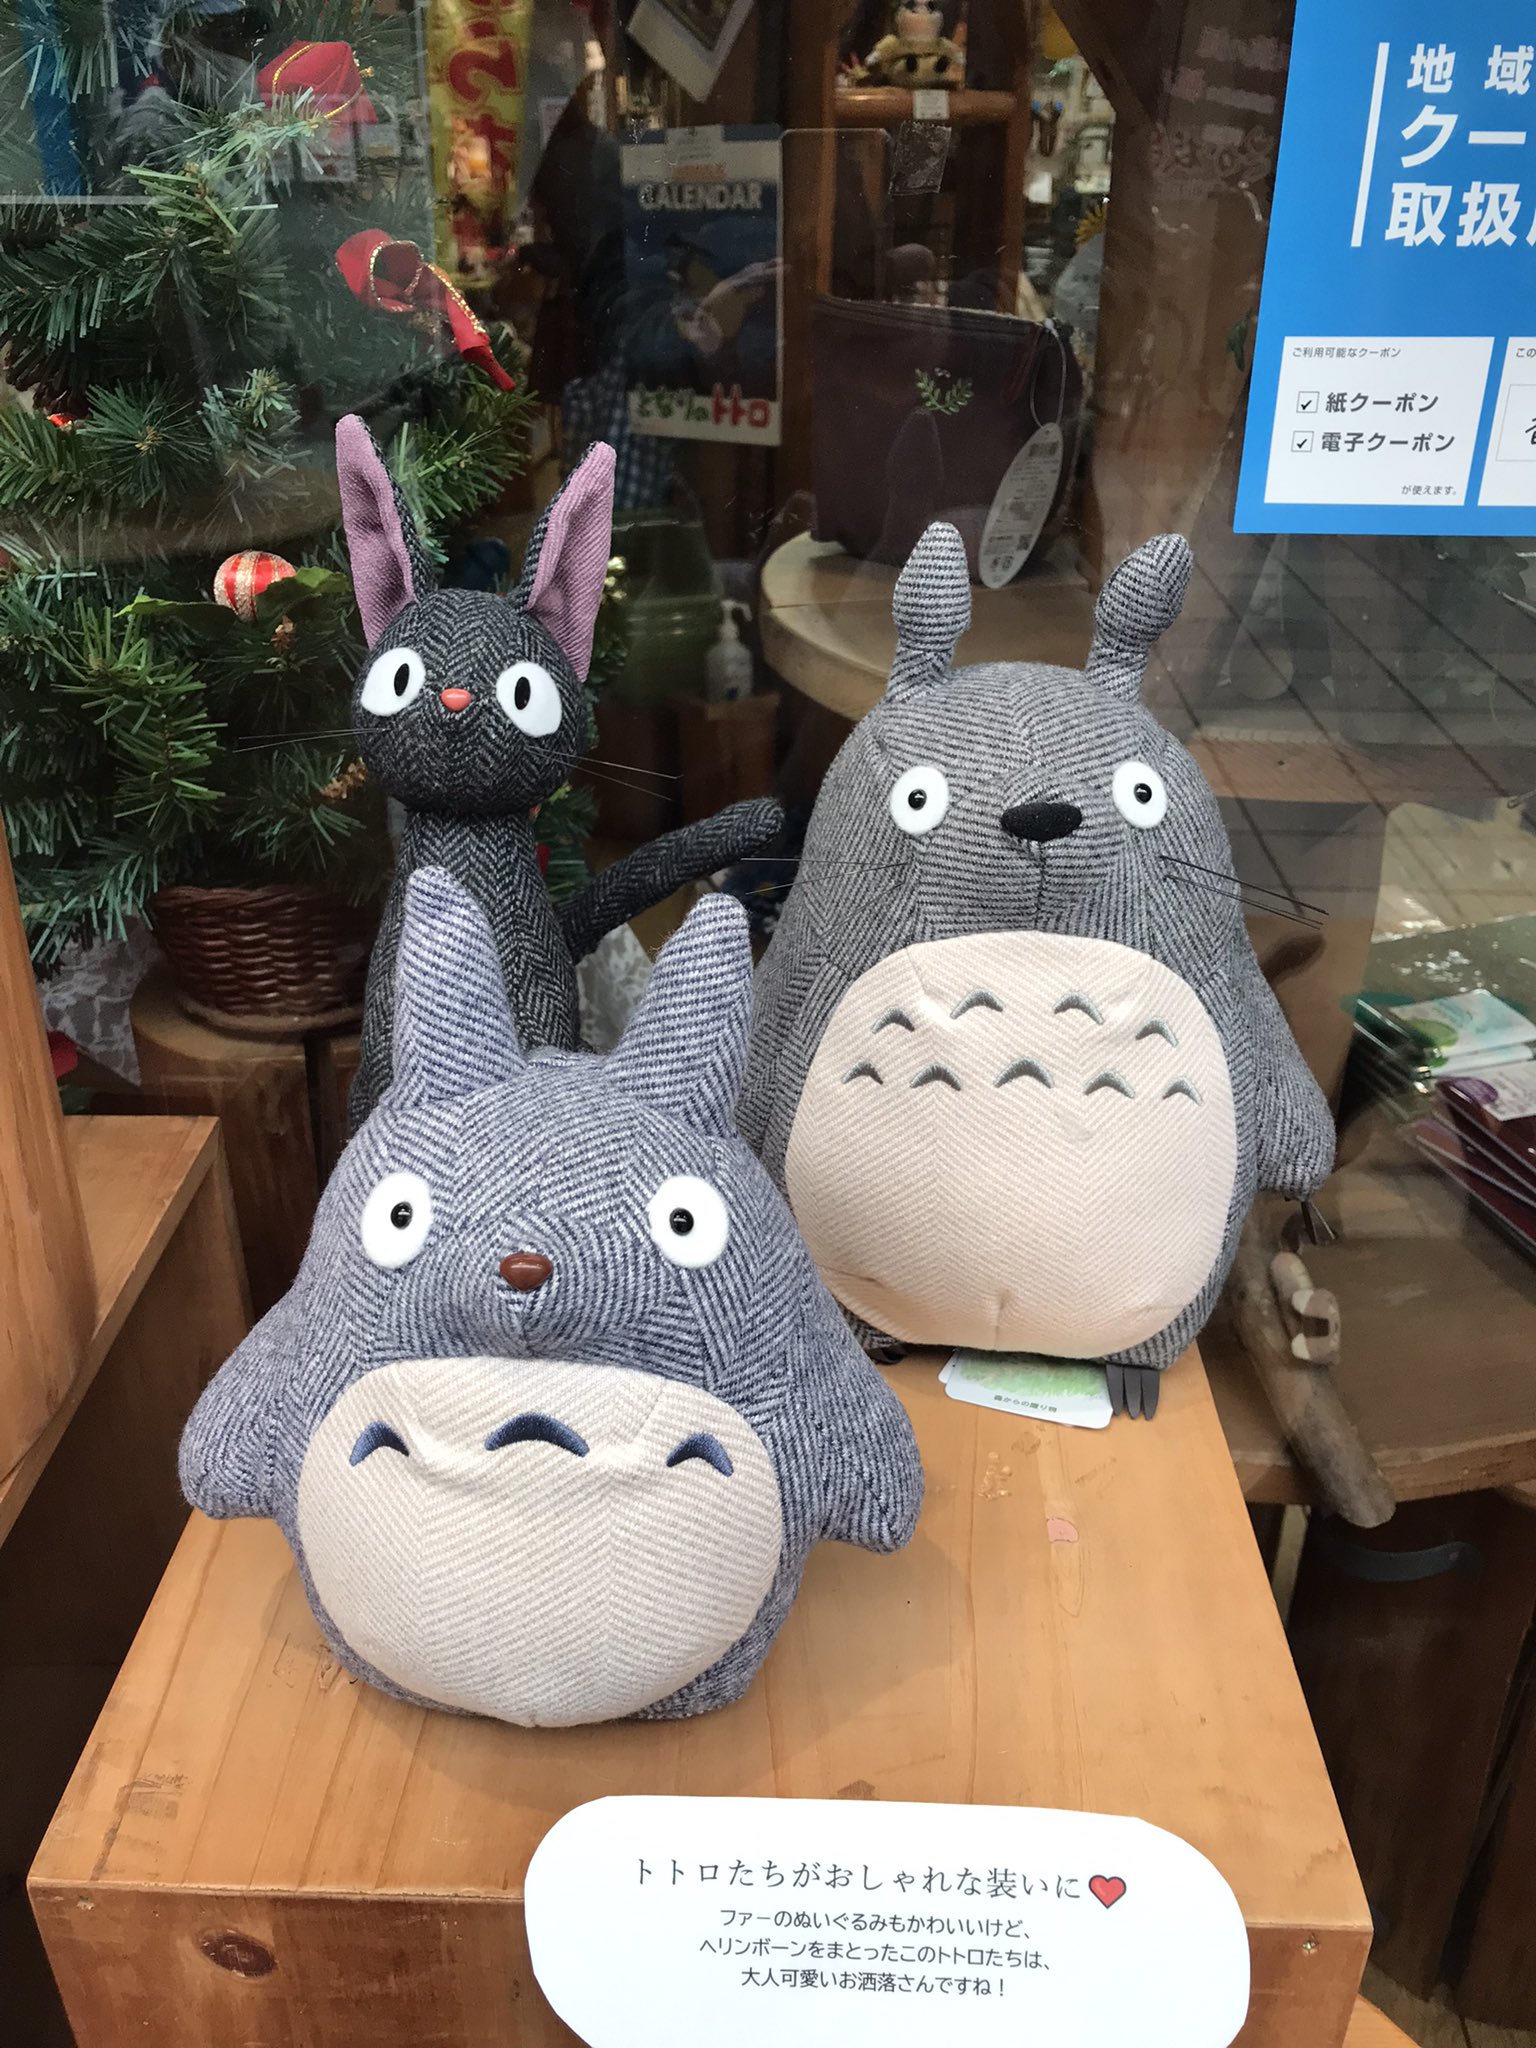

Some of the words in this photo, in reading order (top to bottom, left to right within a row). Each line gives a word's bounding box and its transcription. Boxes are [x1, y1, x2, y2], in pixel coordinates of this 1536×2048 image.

[1407, 43, 1535, 96] 地域
[1400, 104, 1527, 169] クー
[637, 180, 762, 211] CALENDAR
[1384, 181, 1536, 247] 取扱
[1292, 346, 1401, 359] ご利用可能なクーポン
[1325, 391, 1439, 413] 紙クーポン
[1321, 432, 1455, 452] 電子クーポン
[1401, 484, 1458, 497] が使えます。
[638, 1858, 1081, 1899] トトロたちがおしゃれな装いに
[720, 1909, 1030, 1940] ファーのぬいぐるみもかわいいけど、
[699, 1937, 1050, 1970] ヘリンボーンをまとったこのトトロたちは、
[741, 1966, 1004, 1997] 大人可愛いお洒落さんですね！
